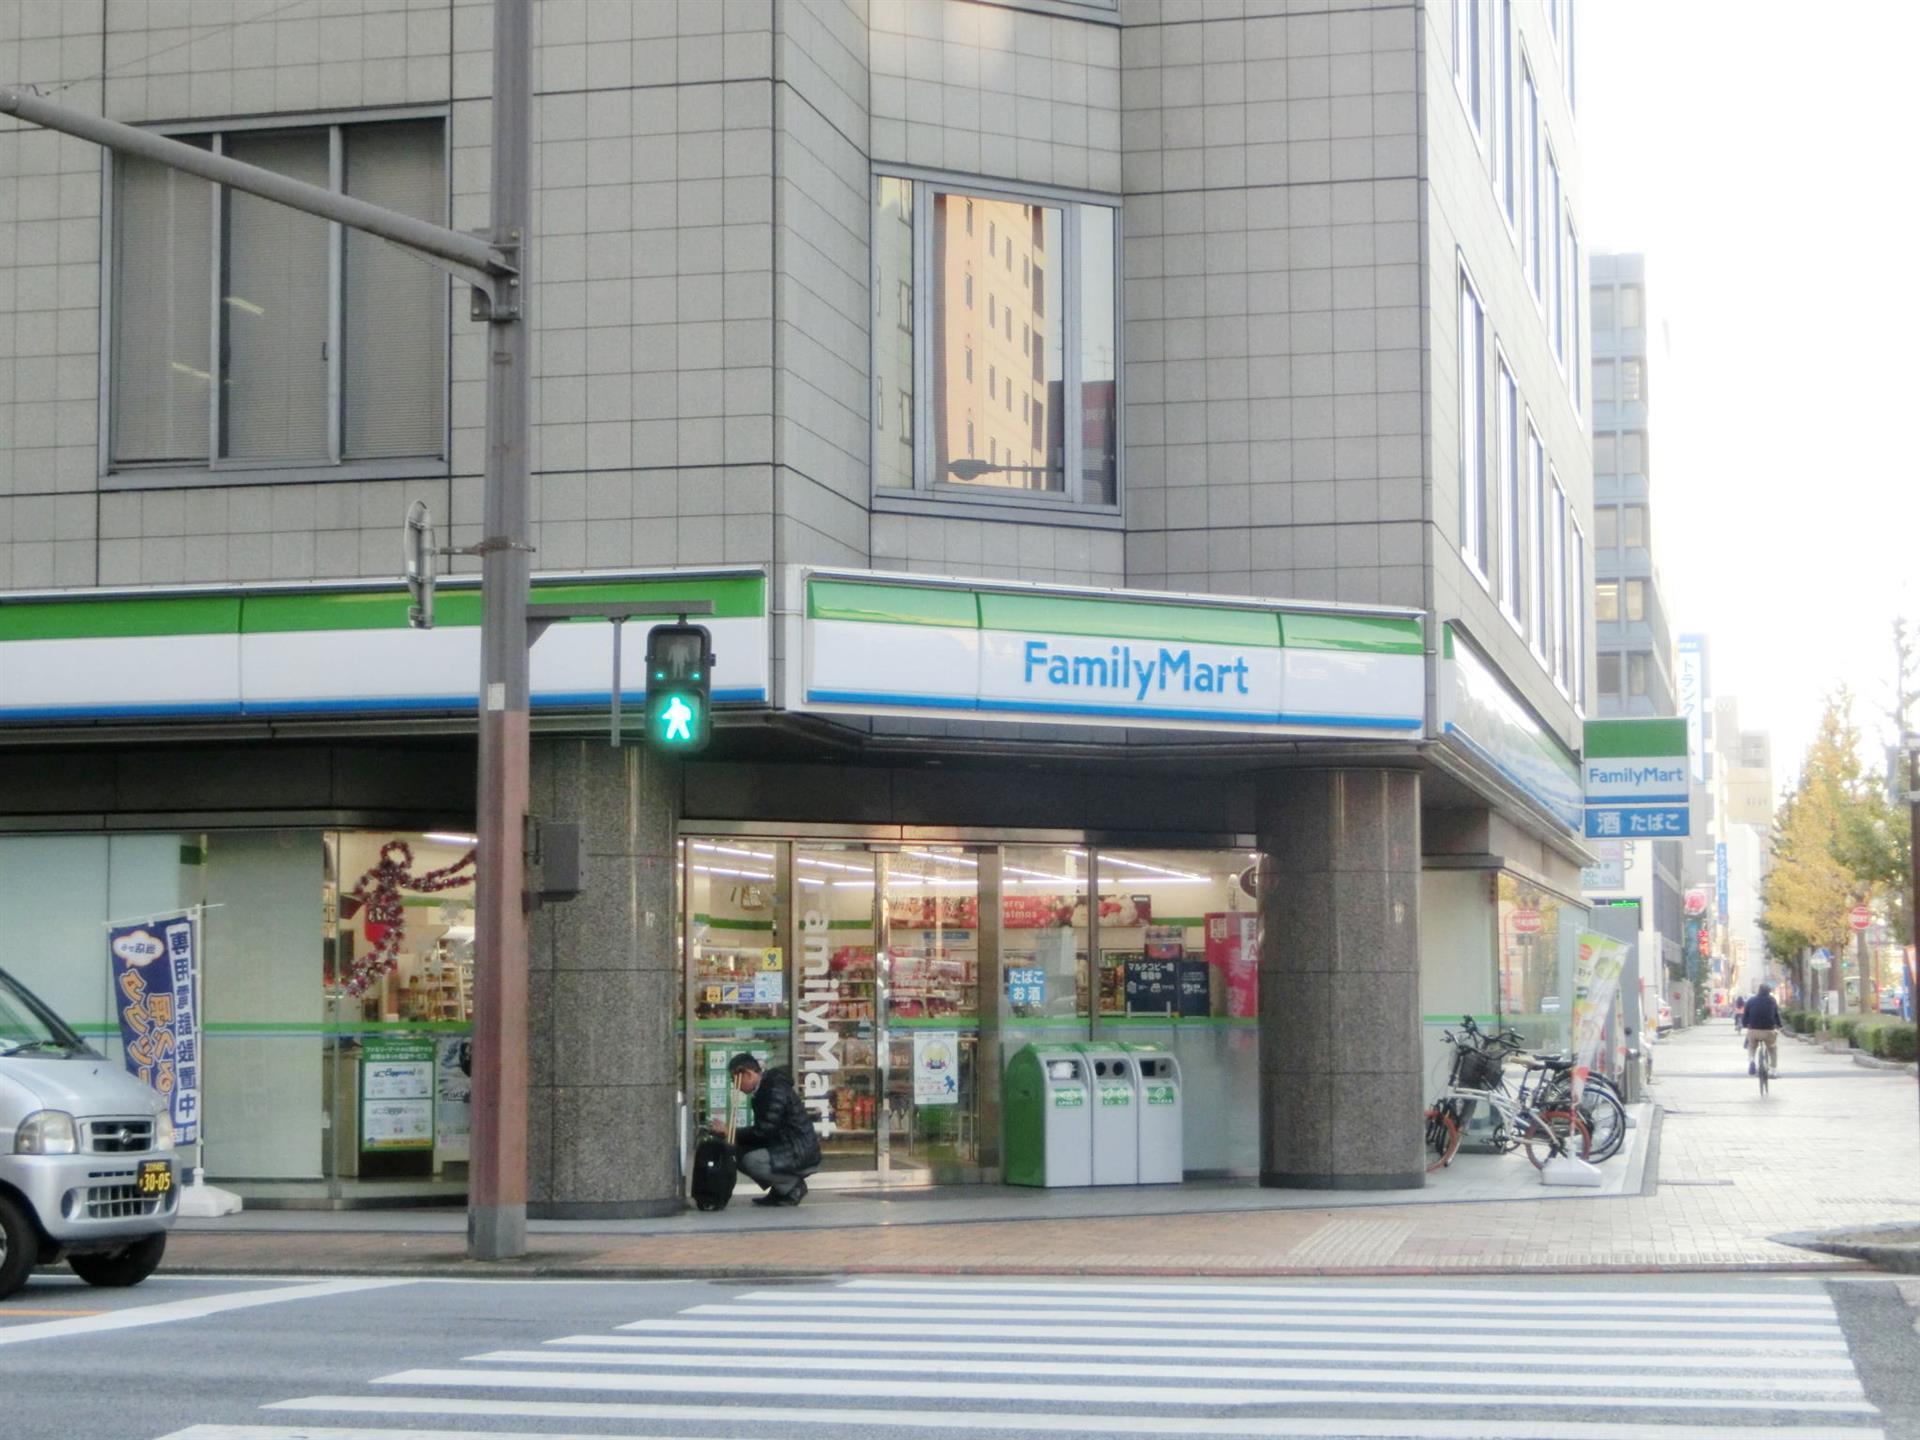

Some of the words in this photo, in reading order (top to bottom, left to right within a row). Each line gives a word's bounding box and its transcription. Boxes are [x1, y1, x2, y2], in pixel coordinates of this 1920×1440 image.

[1024, 641, 1249, 700] FamilyMart
[1588, 766, 1684, 787] FamilyMart
[1597, 811, 1622, 835] 酒
[1629, 813, 1680, 832] たばこ
[1009, 970, 1044, 984] たばこ
